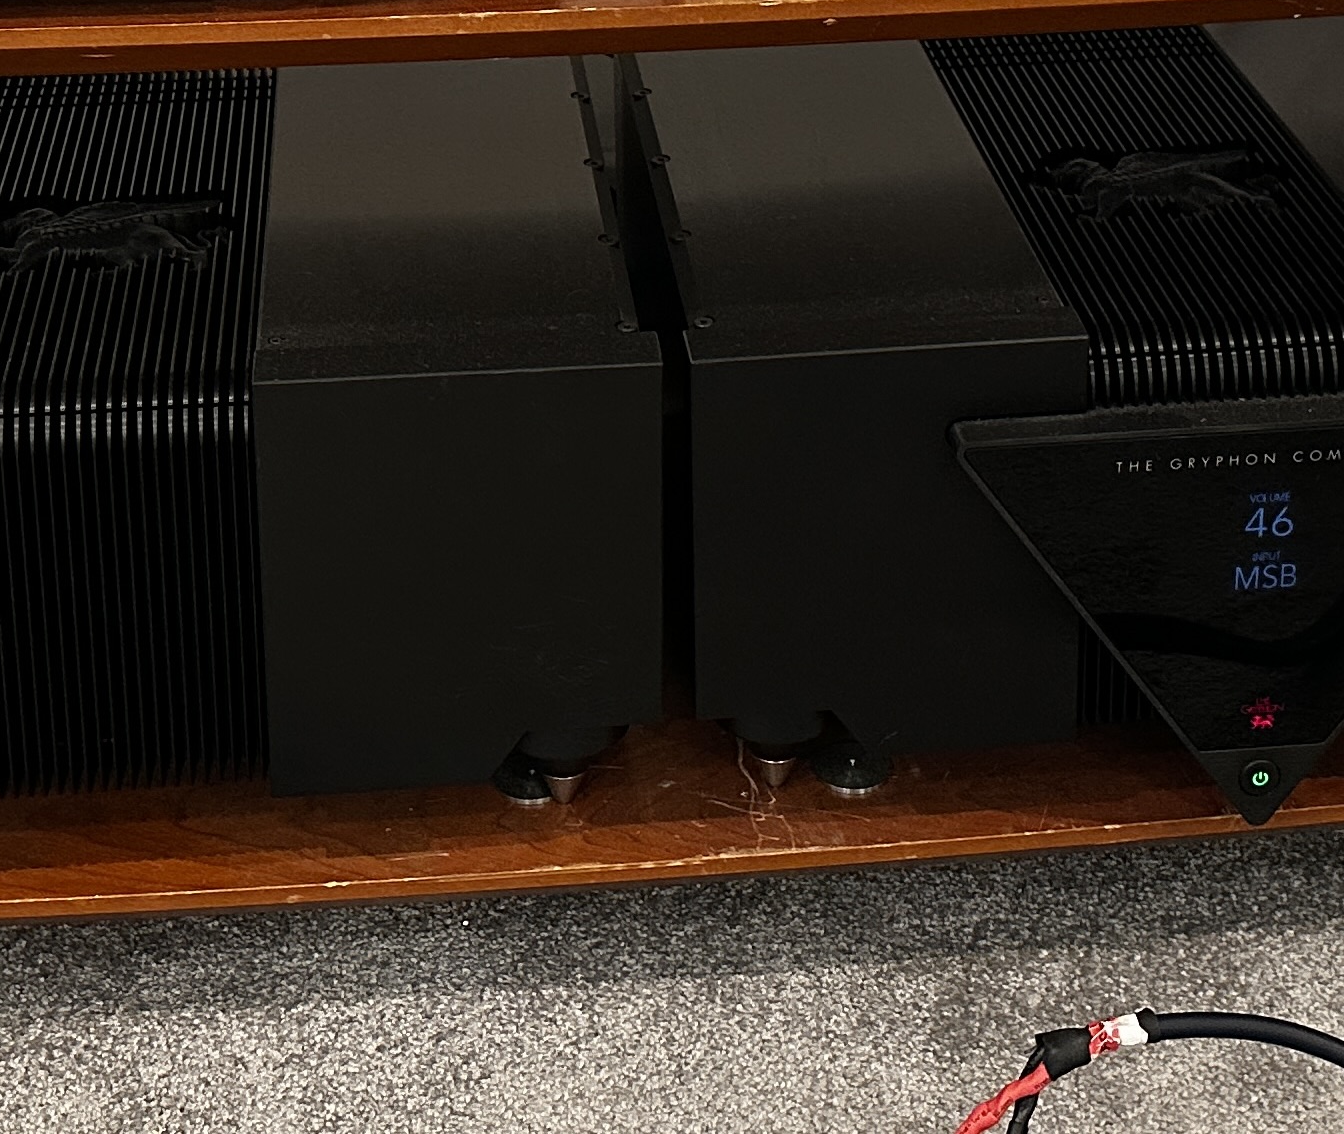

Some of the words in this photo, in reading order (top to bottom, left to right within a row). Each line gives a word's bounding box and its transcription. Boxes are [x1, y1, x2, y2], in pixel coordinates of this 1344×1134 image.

[1116, 459, 1154, 473] THE
[1170, 452, 1277, 470] GRYPHON
[1249, 491, 1291, 503] VOLUME
[1245, 506, 1294, 538] 46
[1234, 563, 1298, 590] MSB
